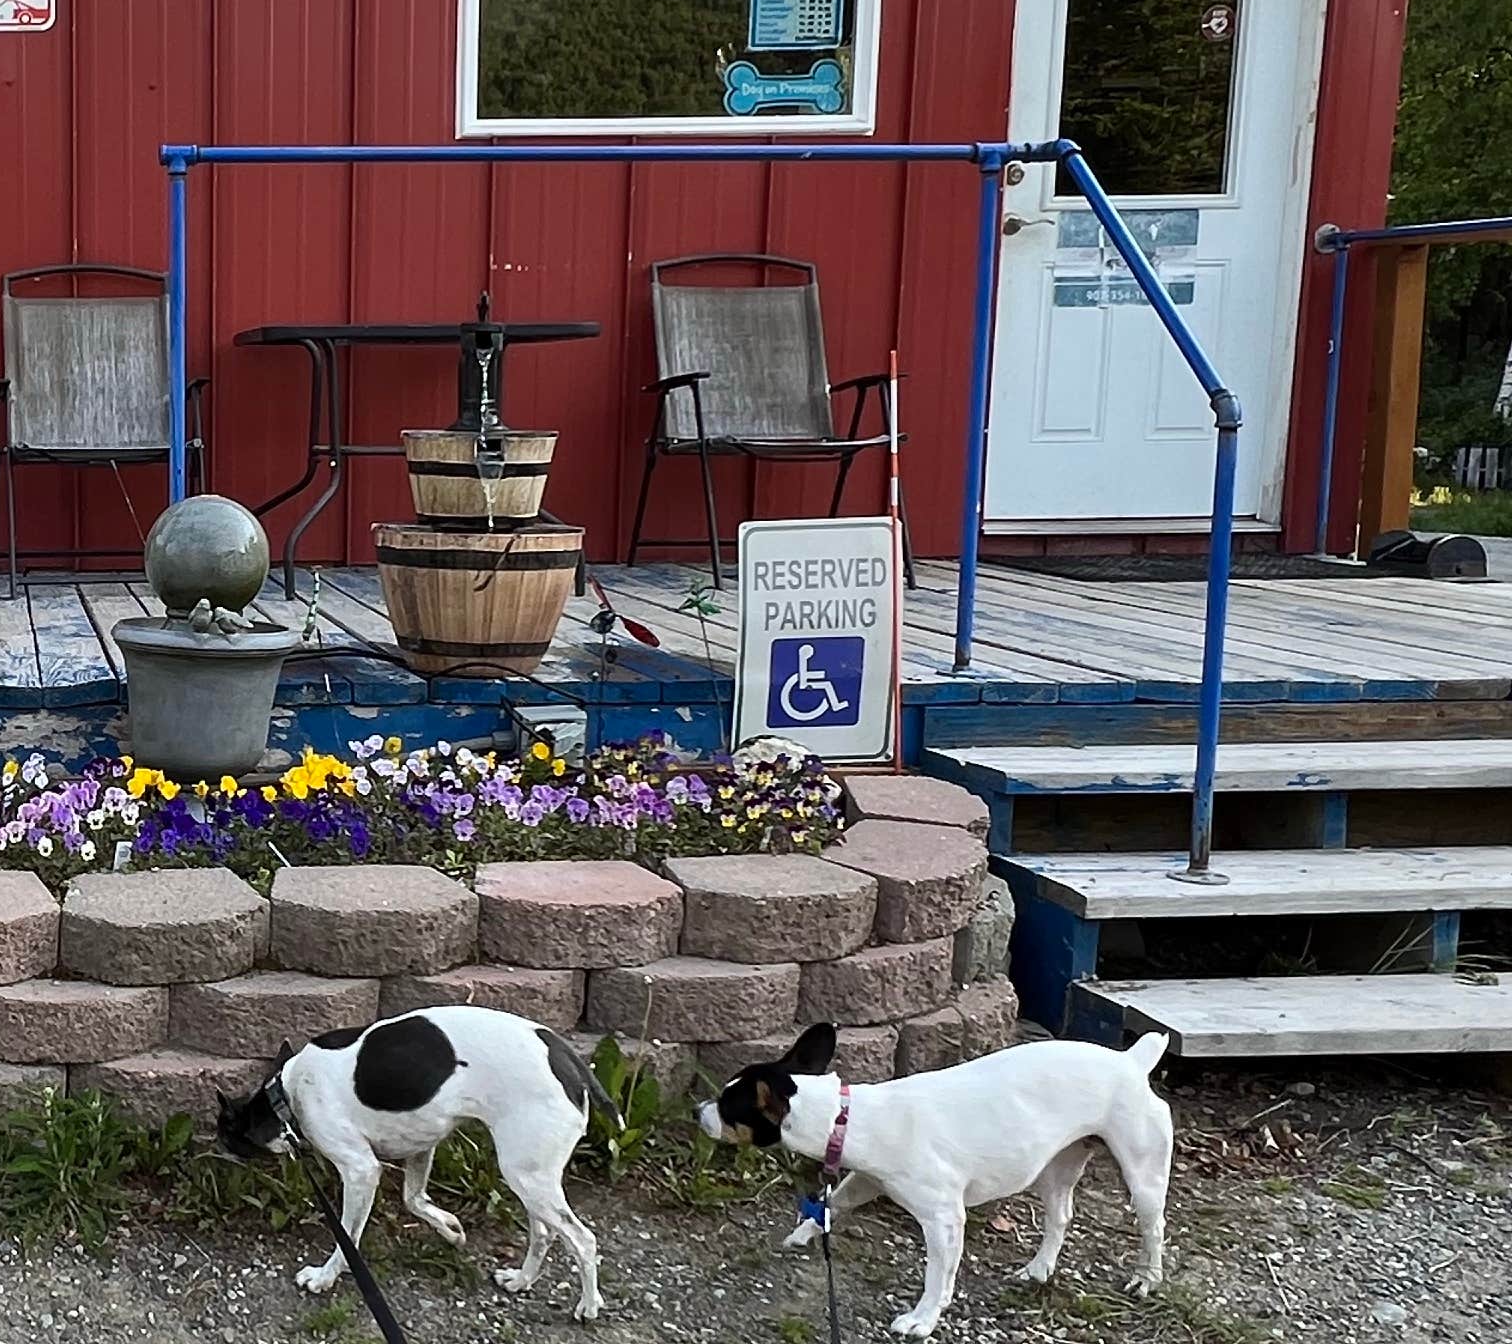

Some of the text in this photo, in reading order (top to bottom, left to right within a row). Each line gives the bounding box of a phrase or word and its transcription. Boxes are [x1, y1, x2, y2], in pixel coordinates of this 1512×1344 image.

[741, 82, 764, 99] Dog
[753, 557, 887, 591] RESERVED
[763, 597, 877, 631] PARKING
